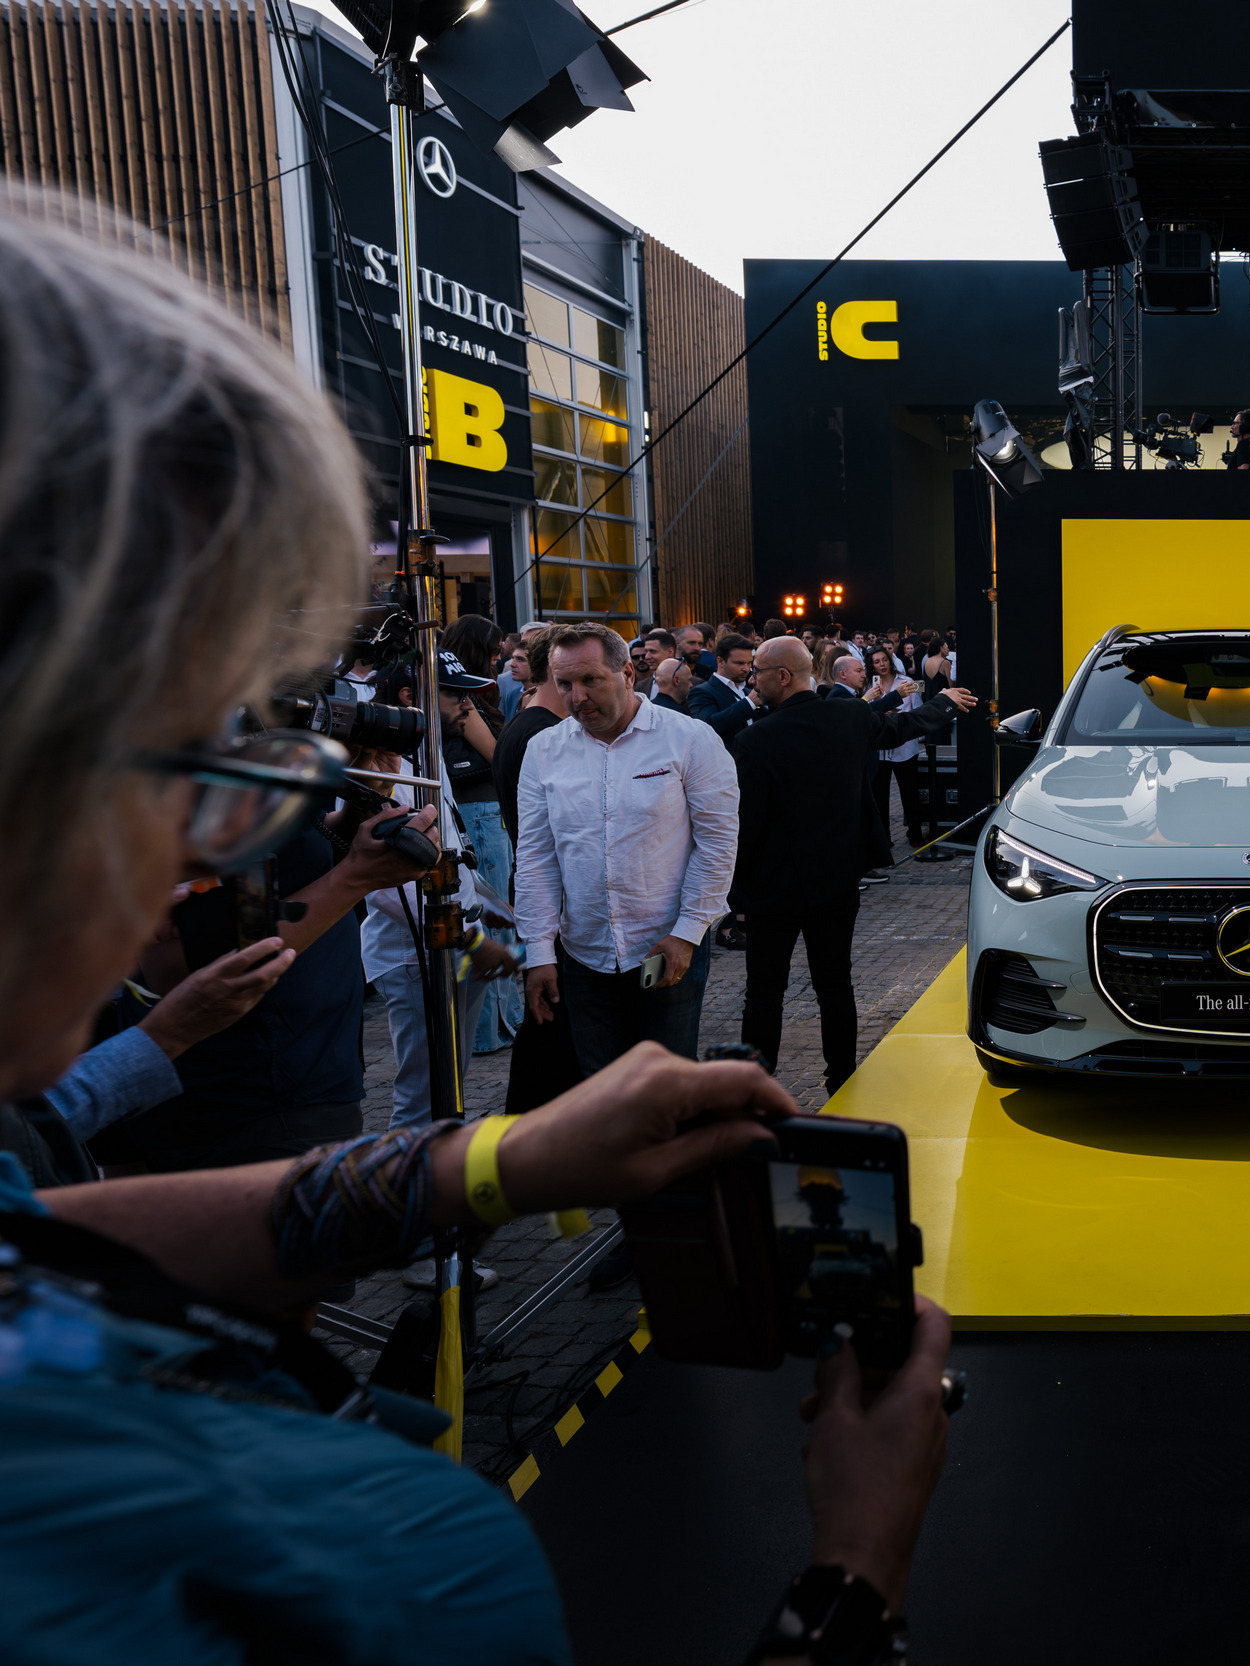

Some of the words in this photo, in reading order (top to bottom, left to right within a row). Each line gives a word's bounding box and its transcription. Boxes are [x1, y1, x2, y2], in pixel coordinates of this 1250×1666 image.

[364, 244, 513, 336] SUDIO
[392, 313, 498, 365] RSZAWA
[816, 300, 829, 361] STUDIO
[830, 300, 900, 360] C
[427, 368, 508, 472] B
[1195, 995, 1223, 1011] The
